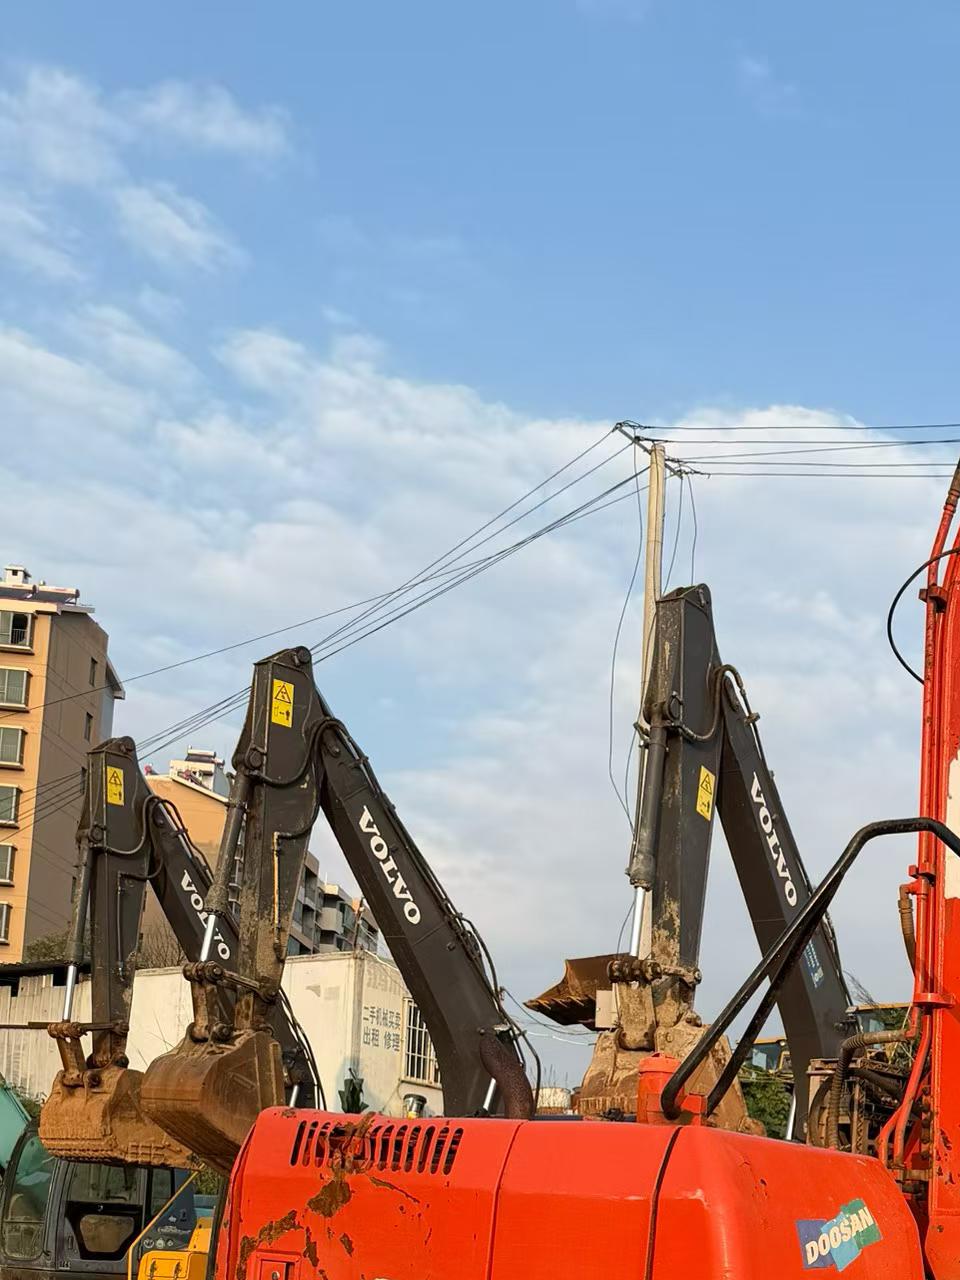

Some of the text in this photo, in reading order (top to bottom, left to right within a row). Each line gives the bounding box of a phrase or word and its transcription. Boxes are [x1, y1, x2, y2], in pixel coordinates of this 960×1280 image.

[359, 805, 421, 925] VOLVO
[751, 771, 798, 907] VOLVO
[805, 1207, 874, 1265] DOOSAN
